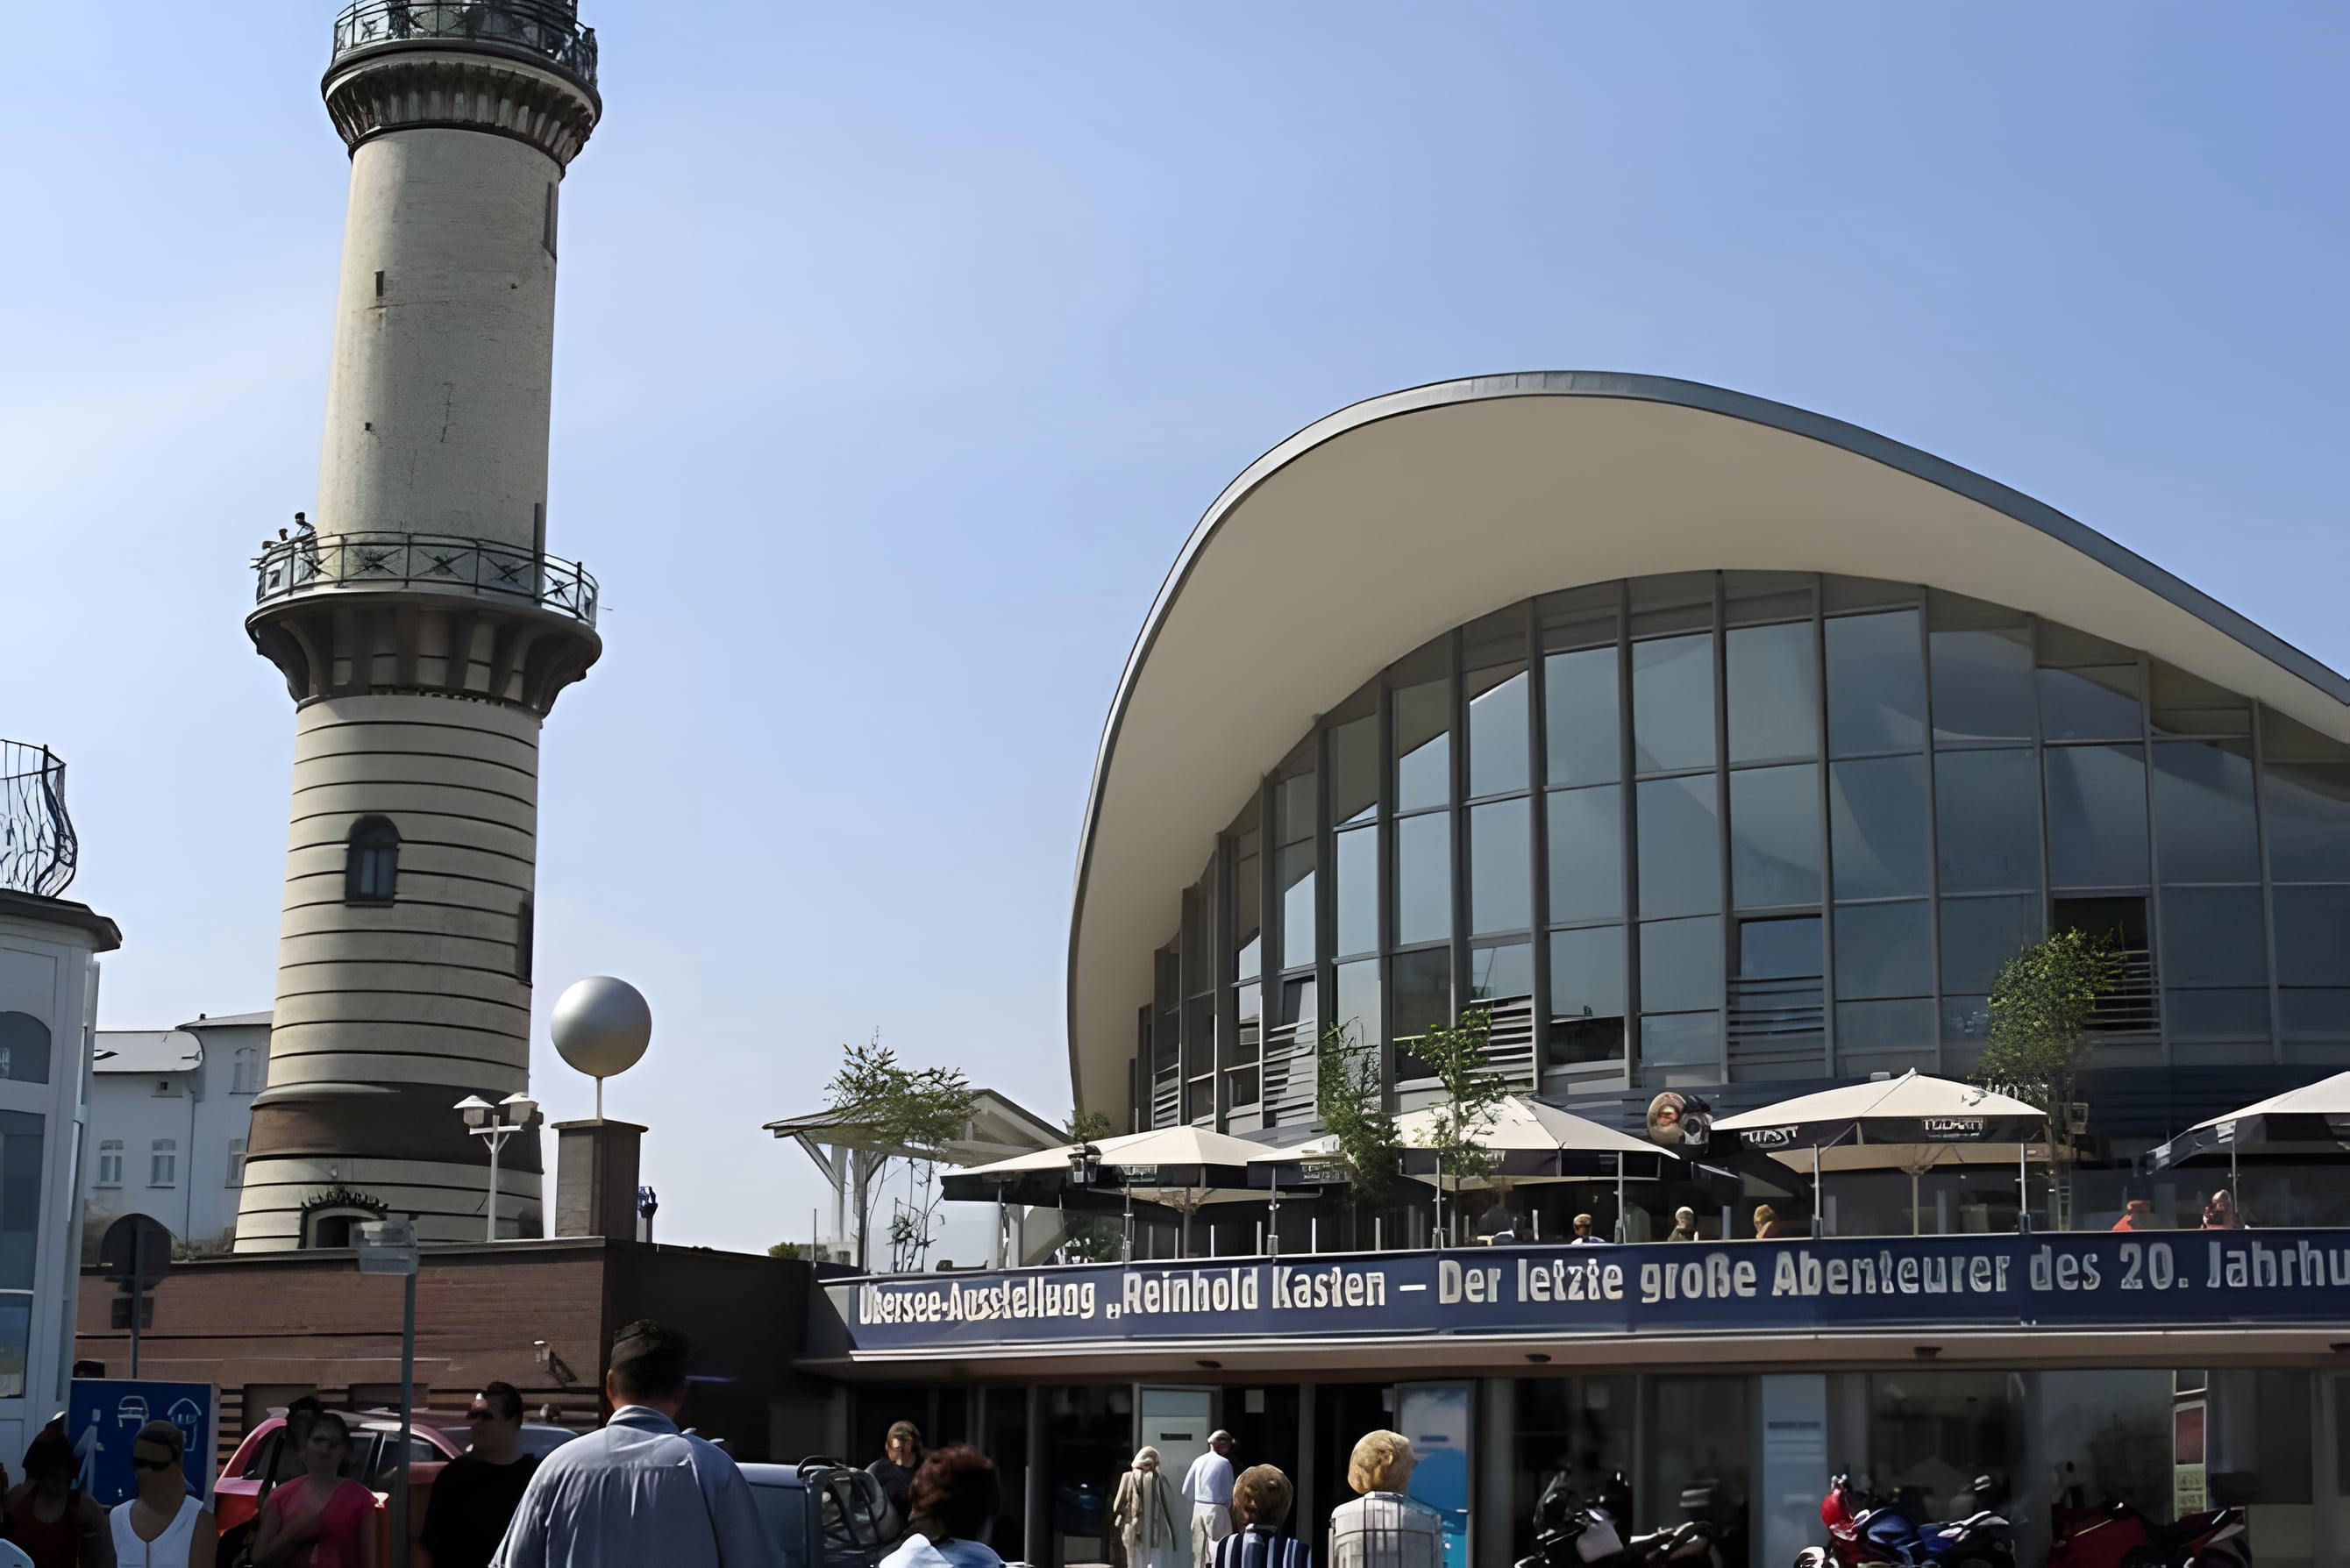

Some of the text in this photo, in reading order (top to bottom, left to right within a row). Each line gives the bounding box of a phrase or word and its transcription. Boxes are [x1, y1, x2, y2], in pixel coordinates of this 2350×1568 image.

[1439, 1259, 1501, 1305] Der
[1641, 1251, 1756, 1304] große
[2029, 1244, 2101, 1291] des
[2119, 1242, 2189, 1290] 20.
